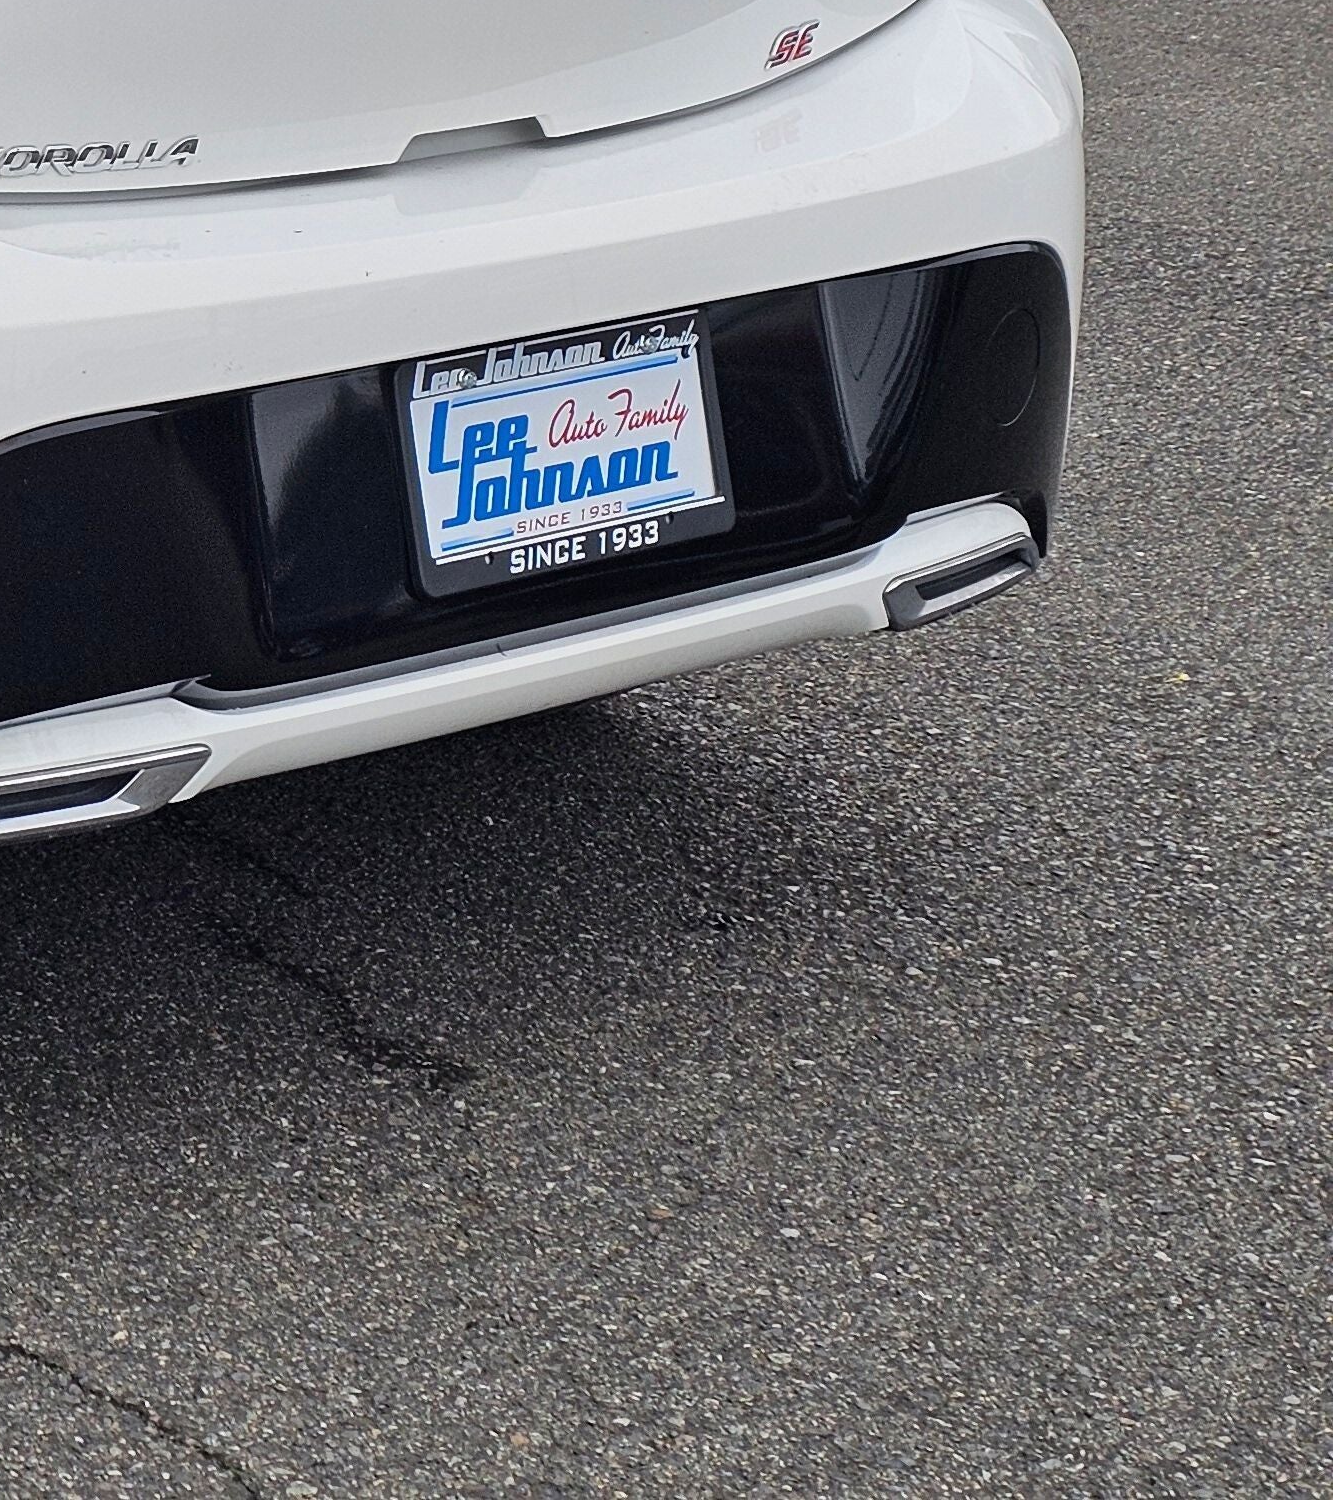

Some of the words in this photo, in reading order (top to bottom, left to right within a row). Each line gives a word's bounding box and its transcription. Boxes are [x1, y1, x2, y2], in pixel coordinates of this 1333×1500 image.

[764, 19, 820, 69] SE
[475, 340, 604, 384] Johnson
[649, 319, 699, 356] Family
[428, 400, 537, 474] Lee
[548, 399, 608, 447] Auto
[608, 379, 688, 440] Family
[441, 441, 678, 529] Johnson
[517, 511, 571, 534] SINCE
[581, 501, 622, 521] 1933
[510, 536, 587, 574] SINCE
[598, 520, 659, 554] 1933
